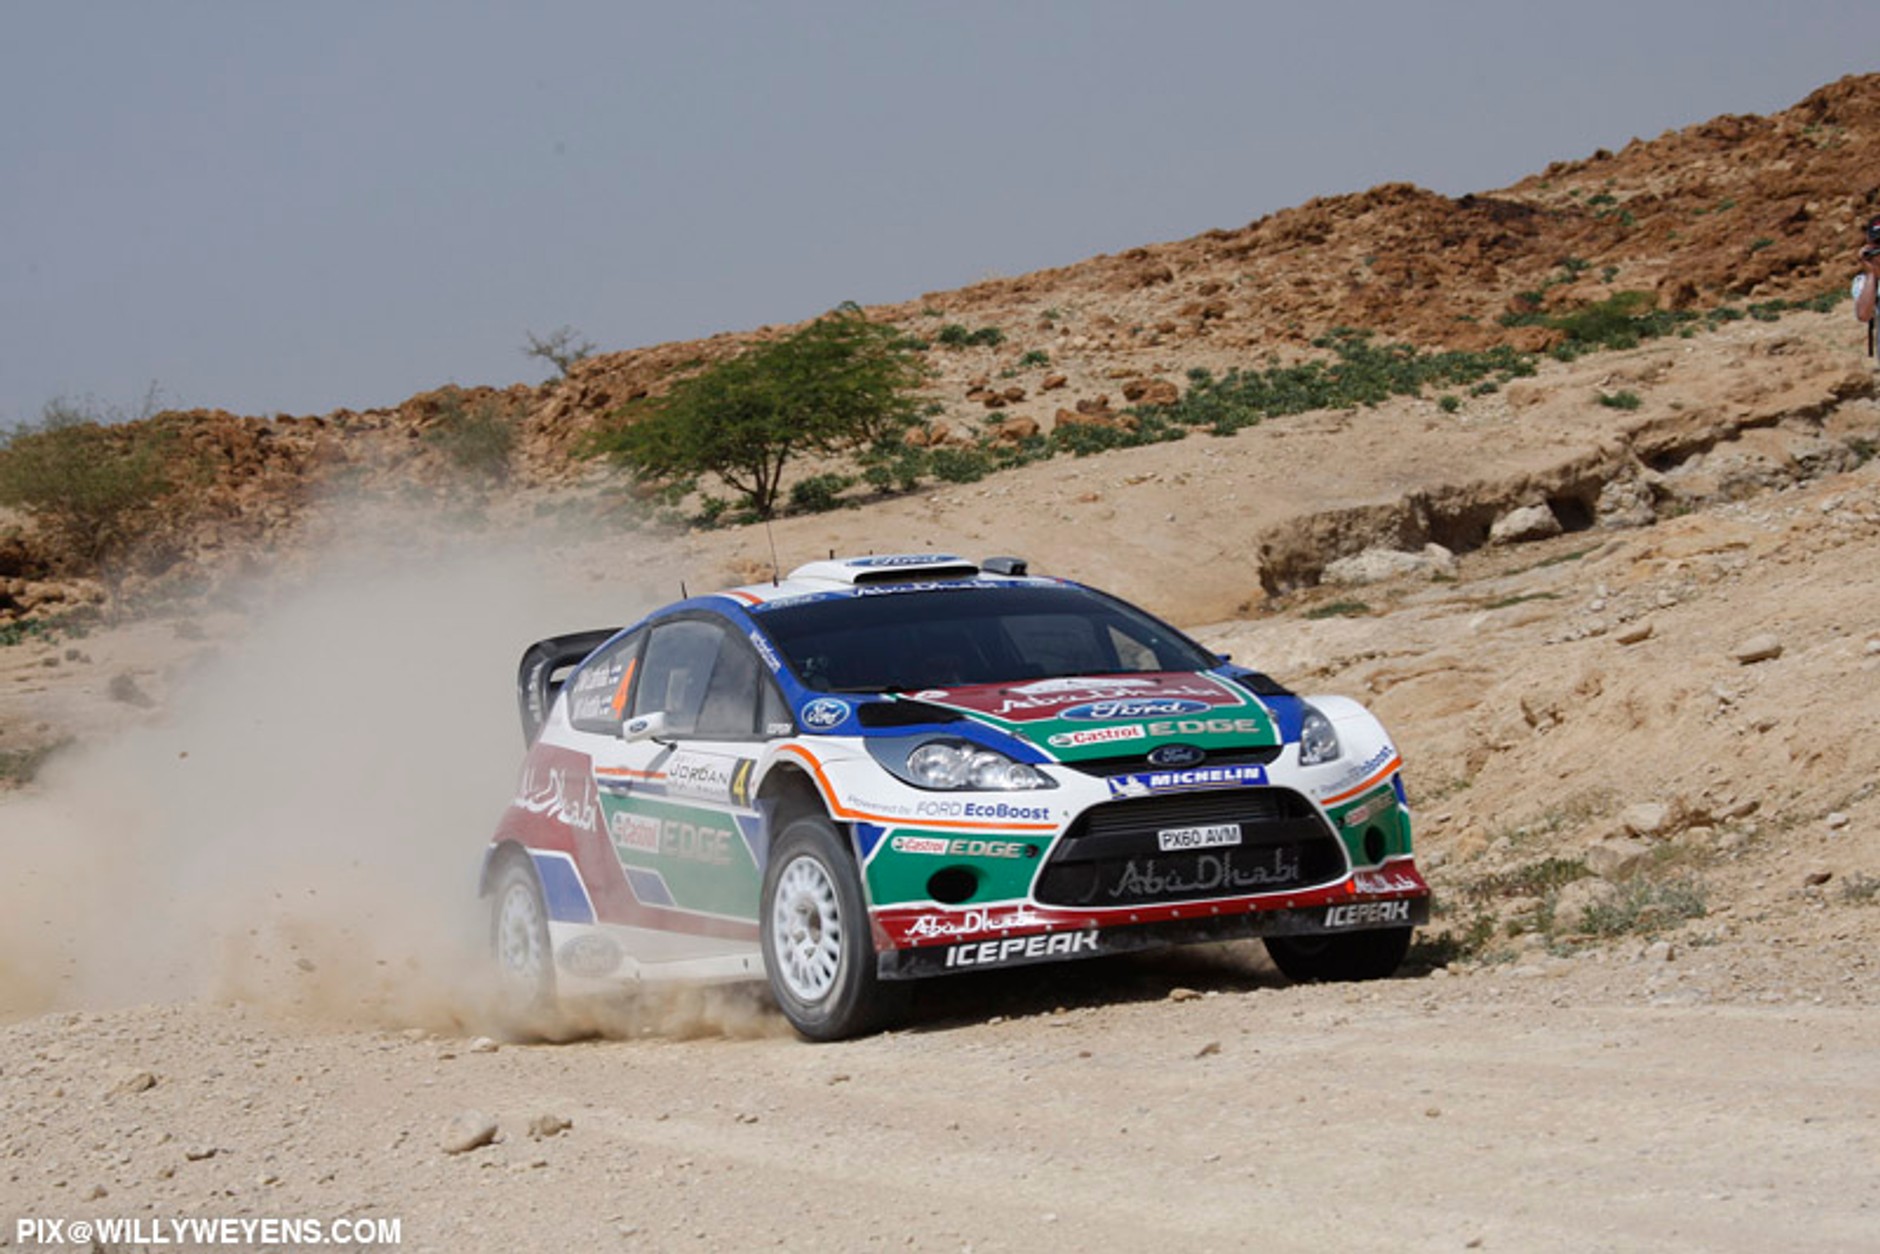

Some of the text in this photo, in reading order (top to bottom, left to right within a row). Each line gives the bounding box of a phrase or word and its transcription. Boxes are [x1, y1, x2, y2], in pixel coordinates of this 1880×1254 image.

[994, 693, 1077, 714] Abu
[1089, 702, 1187, 718] Ford
[1073, 718, 1261, 744] Castrol EDGE
[1162, 749, 1193, 762] Ford
[669, 763, 729, 784] JORDAN
[733, 759, 752, 806] 4
[1150, 766, 1261, 786] MICHELIN
[849, 796, 1050, 820] Powered by FORD EcoBoost
[663, 820, 735, 865] EDGE
[904, 838, 1025, 858] Castrol EDGE
[1162, 824, 1239, 848] PX60 AVM
[1108, 847, 1299, 898] Abu Dhabi
[1324, 900, 1410, 927] ICEPEAK
[904, 914, 964, 938] Abu
[945, 929, 1100, 967] ICEPEAK
